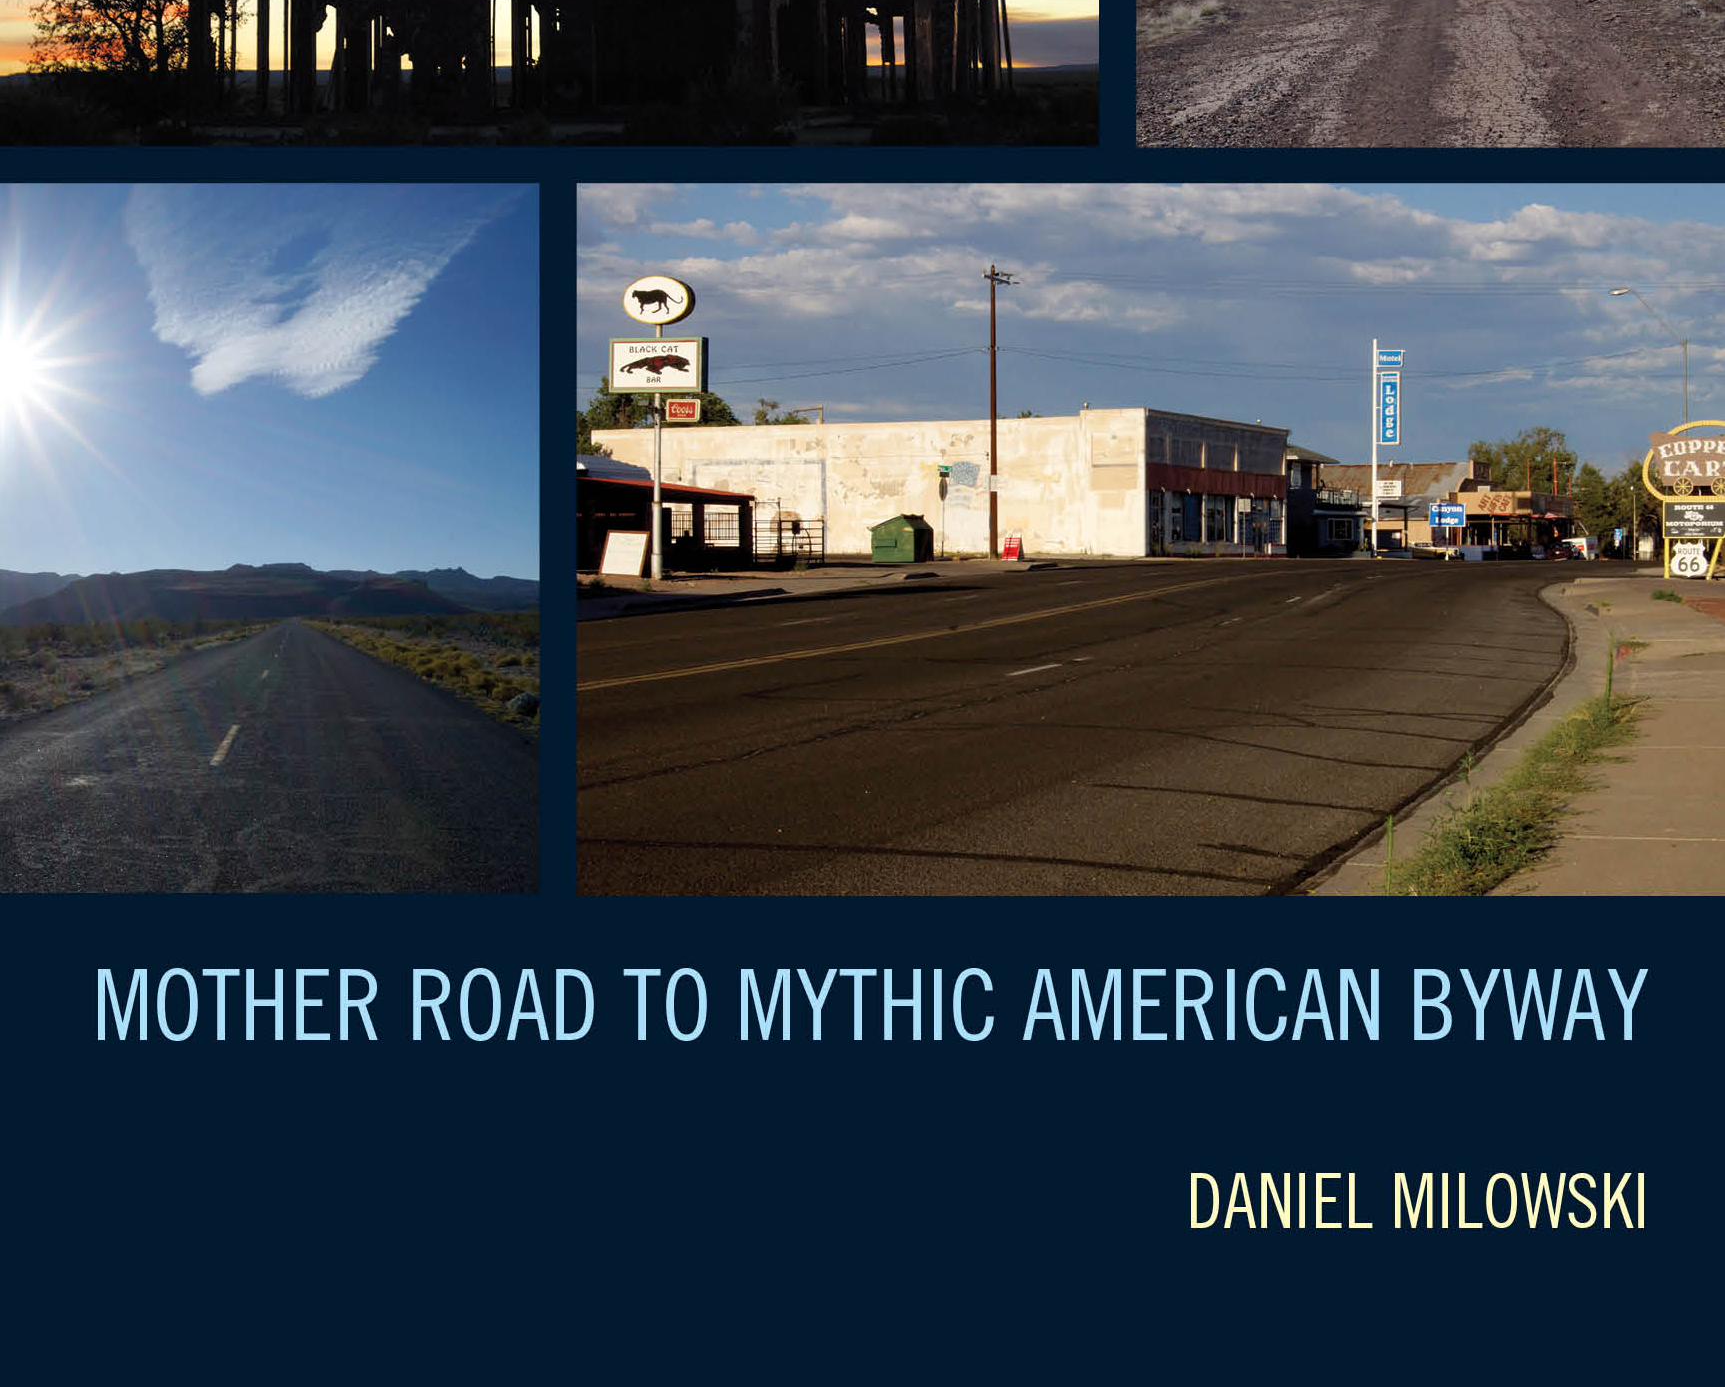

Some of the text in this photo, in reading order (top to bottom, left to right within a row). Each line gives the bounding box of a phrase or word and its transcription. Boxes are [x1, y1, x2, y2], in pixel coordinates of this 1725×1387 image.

[629, 345, 679, 353] BLACK CAT
[646, 376, 661, 384] BAR
[1385, 384, 1396, 438] Lodge
[1664, 460, 1725, 477] CAR
[1431, 505, 1463, 514] Cnyon
[1678, 547, 1701, 555] ROUTE
[1678, 556, 1701, 572] 66
